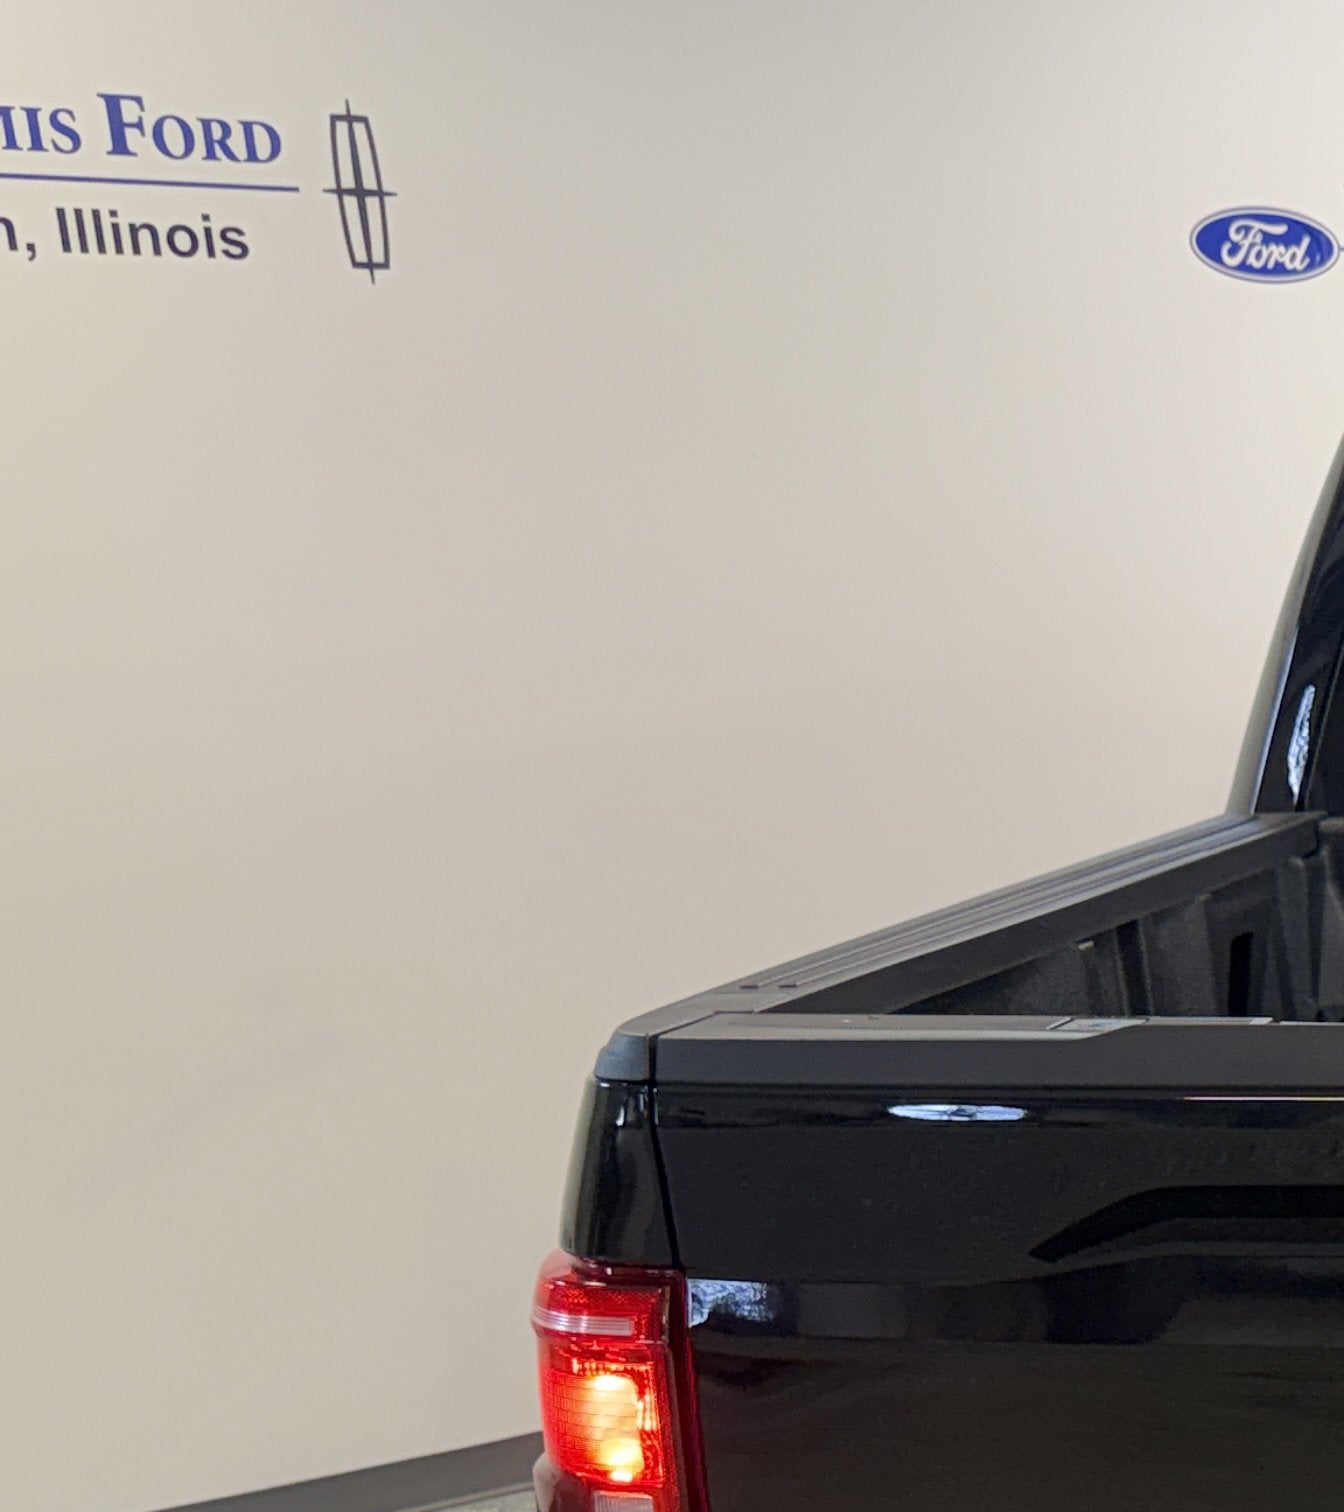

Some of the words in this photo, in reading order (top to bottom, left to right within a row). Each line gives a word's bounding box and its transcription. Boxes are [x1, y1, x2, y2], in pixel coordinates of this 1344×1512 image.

[97, 92, 281, 163] FORD
[55, 207, 250, 260] Illinois
[1219, 218, 1310, 272] Ford
